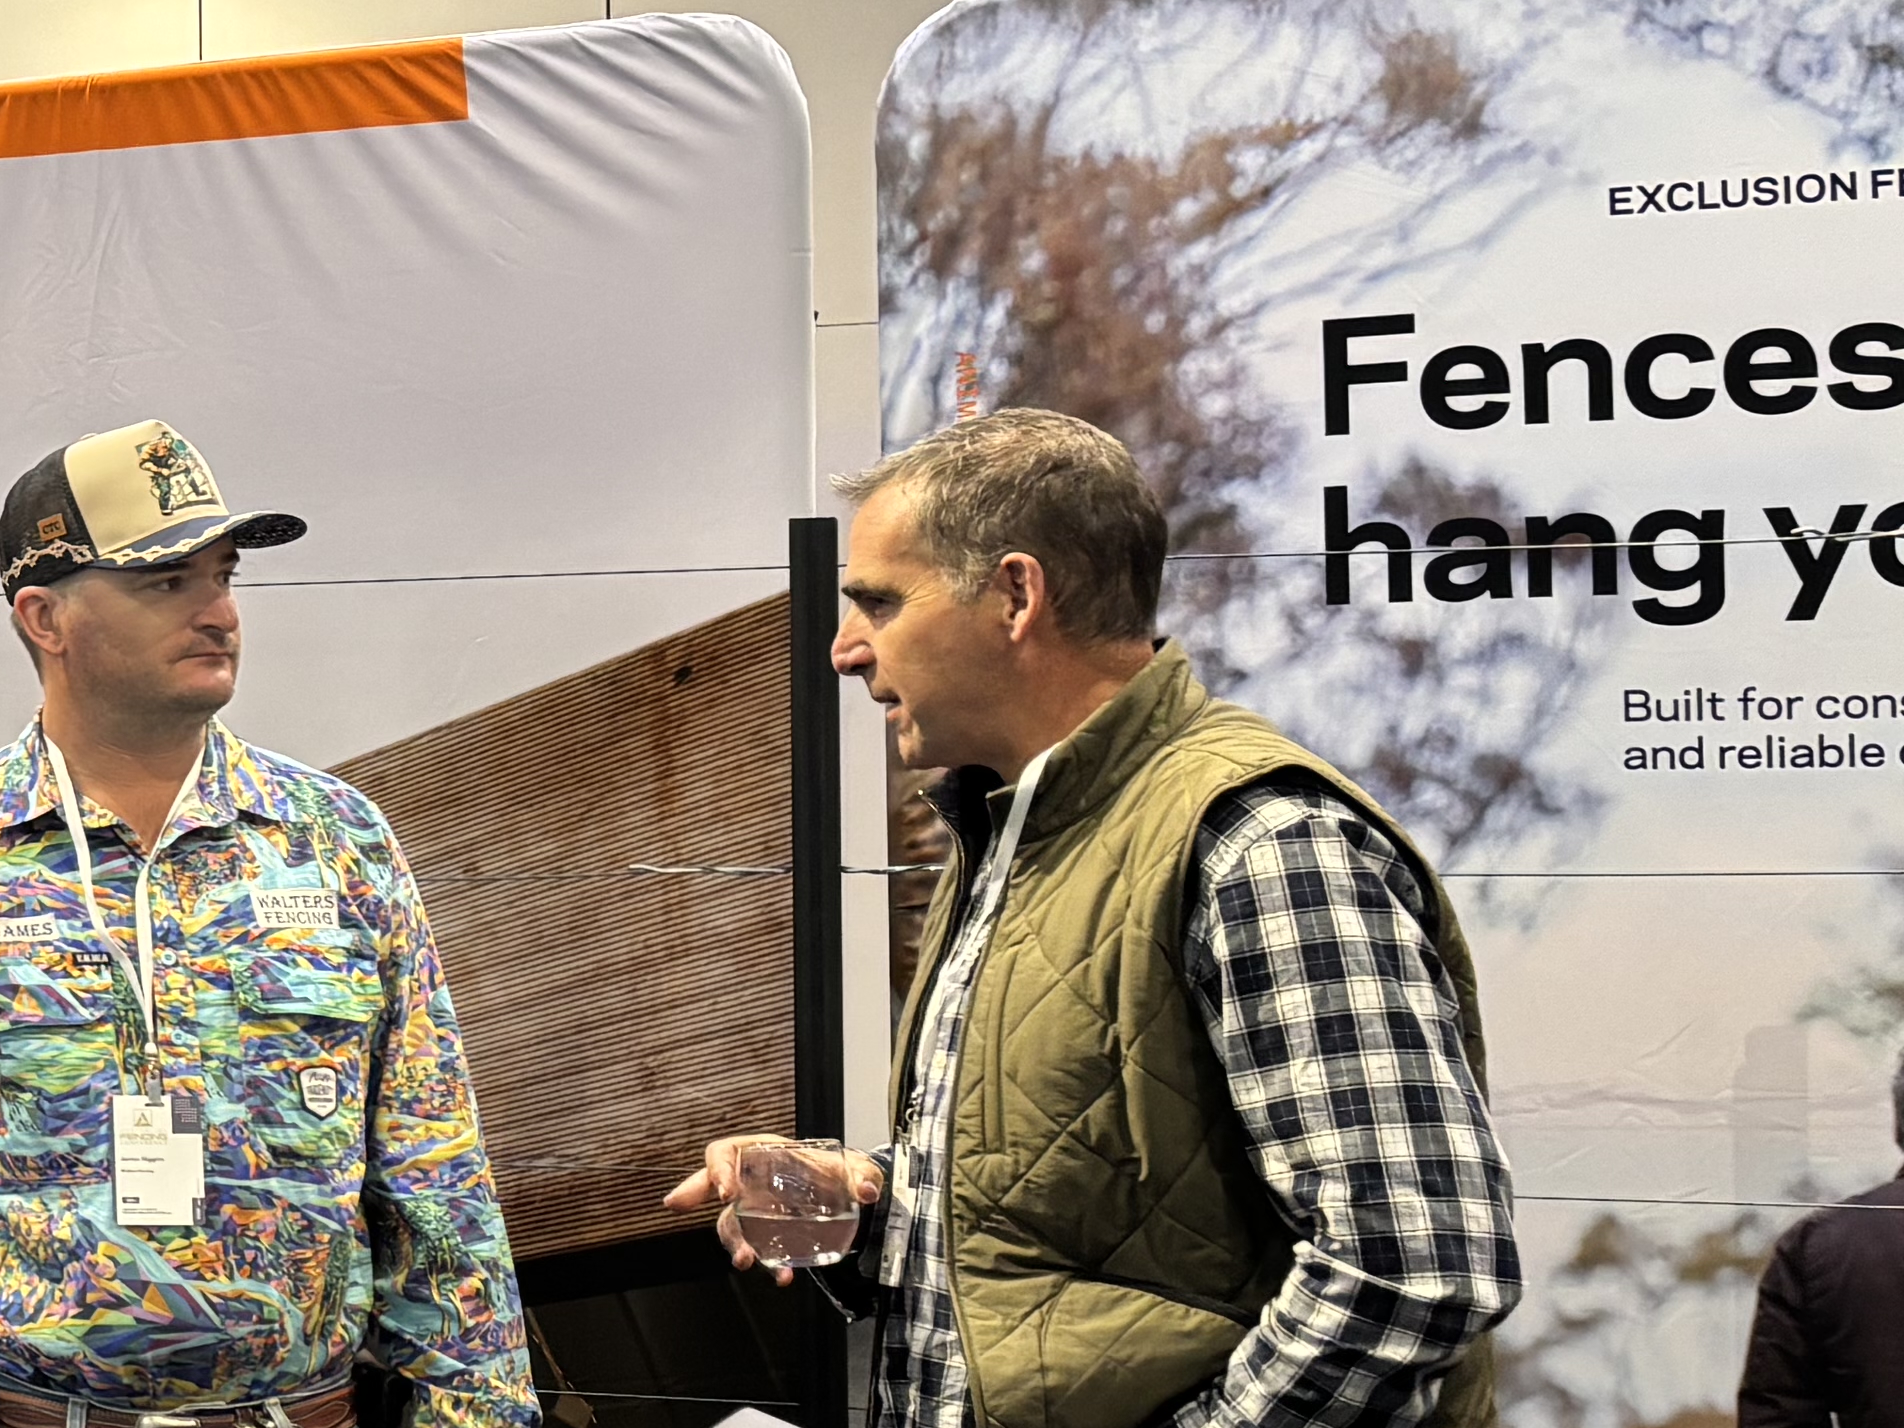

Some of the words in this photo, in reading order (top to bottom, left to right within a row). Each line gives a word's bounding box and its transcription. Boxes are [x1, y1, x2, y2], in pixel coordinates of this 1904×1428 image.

[1608, 171, 1858, 216] EXCLUSION
[955, 351, 979, 419] ANIM
[1322, 313, 1904, 437] Fences
[1323, 485, 1725, 627] hang
[1623, 687, 1726, 722] Built
[1737, 686, 1804, 721] for
[1816, 693, 1904, 720] con
[1623, 735, 1705, 770] and
[1718, 733, 1886, 769] reliable
[257, 894, 335, 910] WALTERS
[264, 910, 334, 926] FENCING
